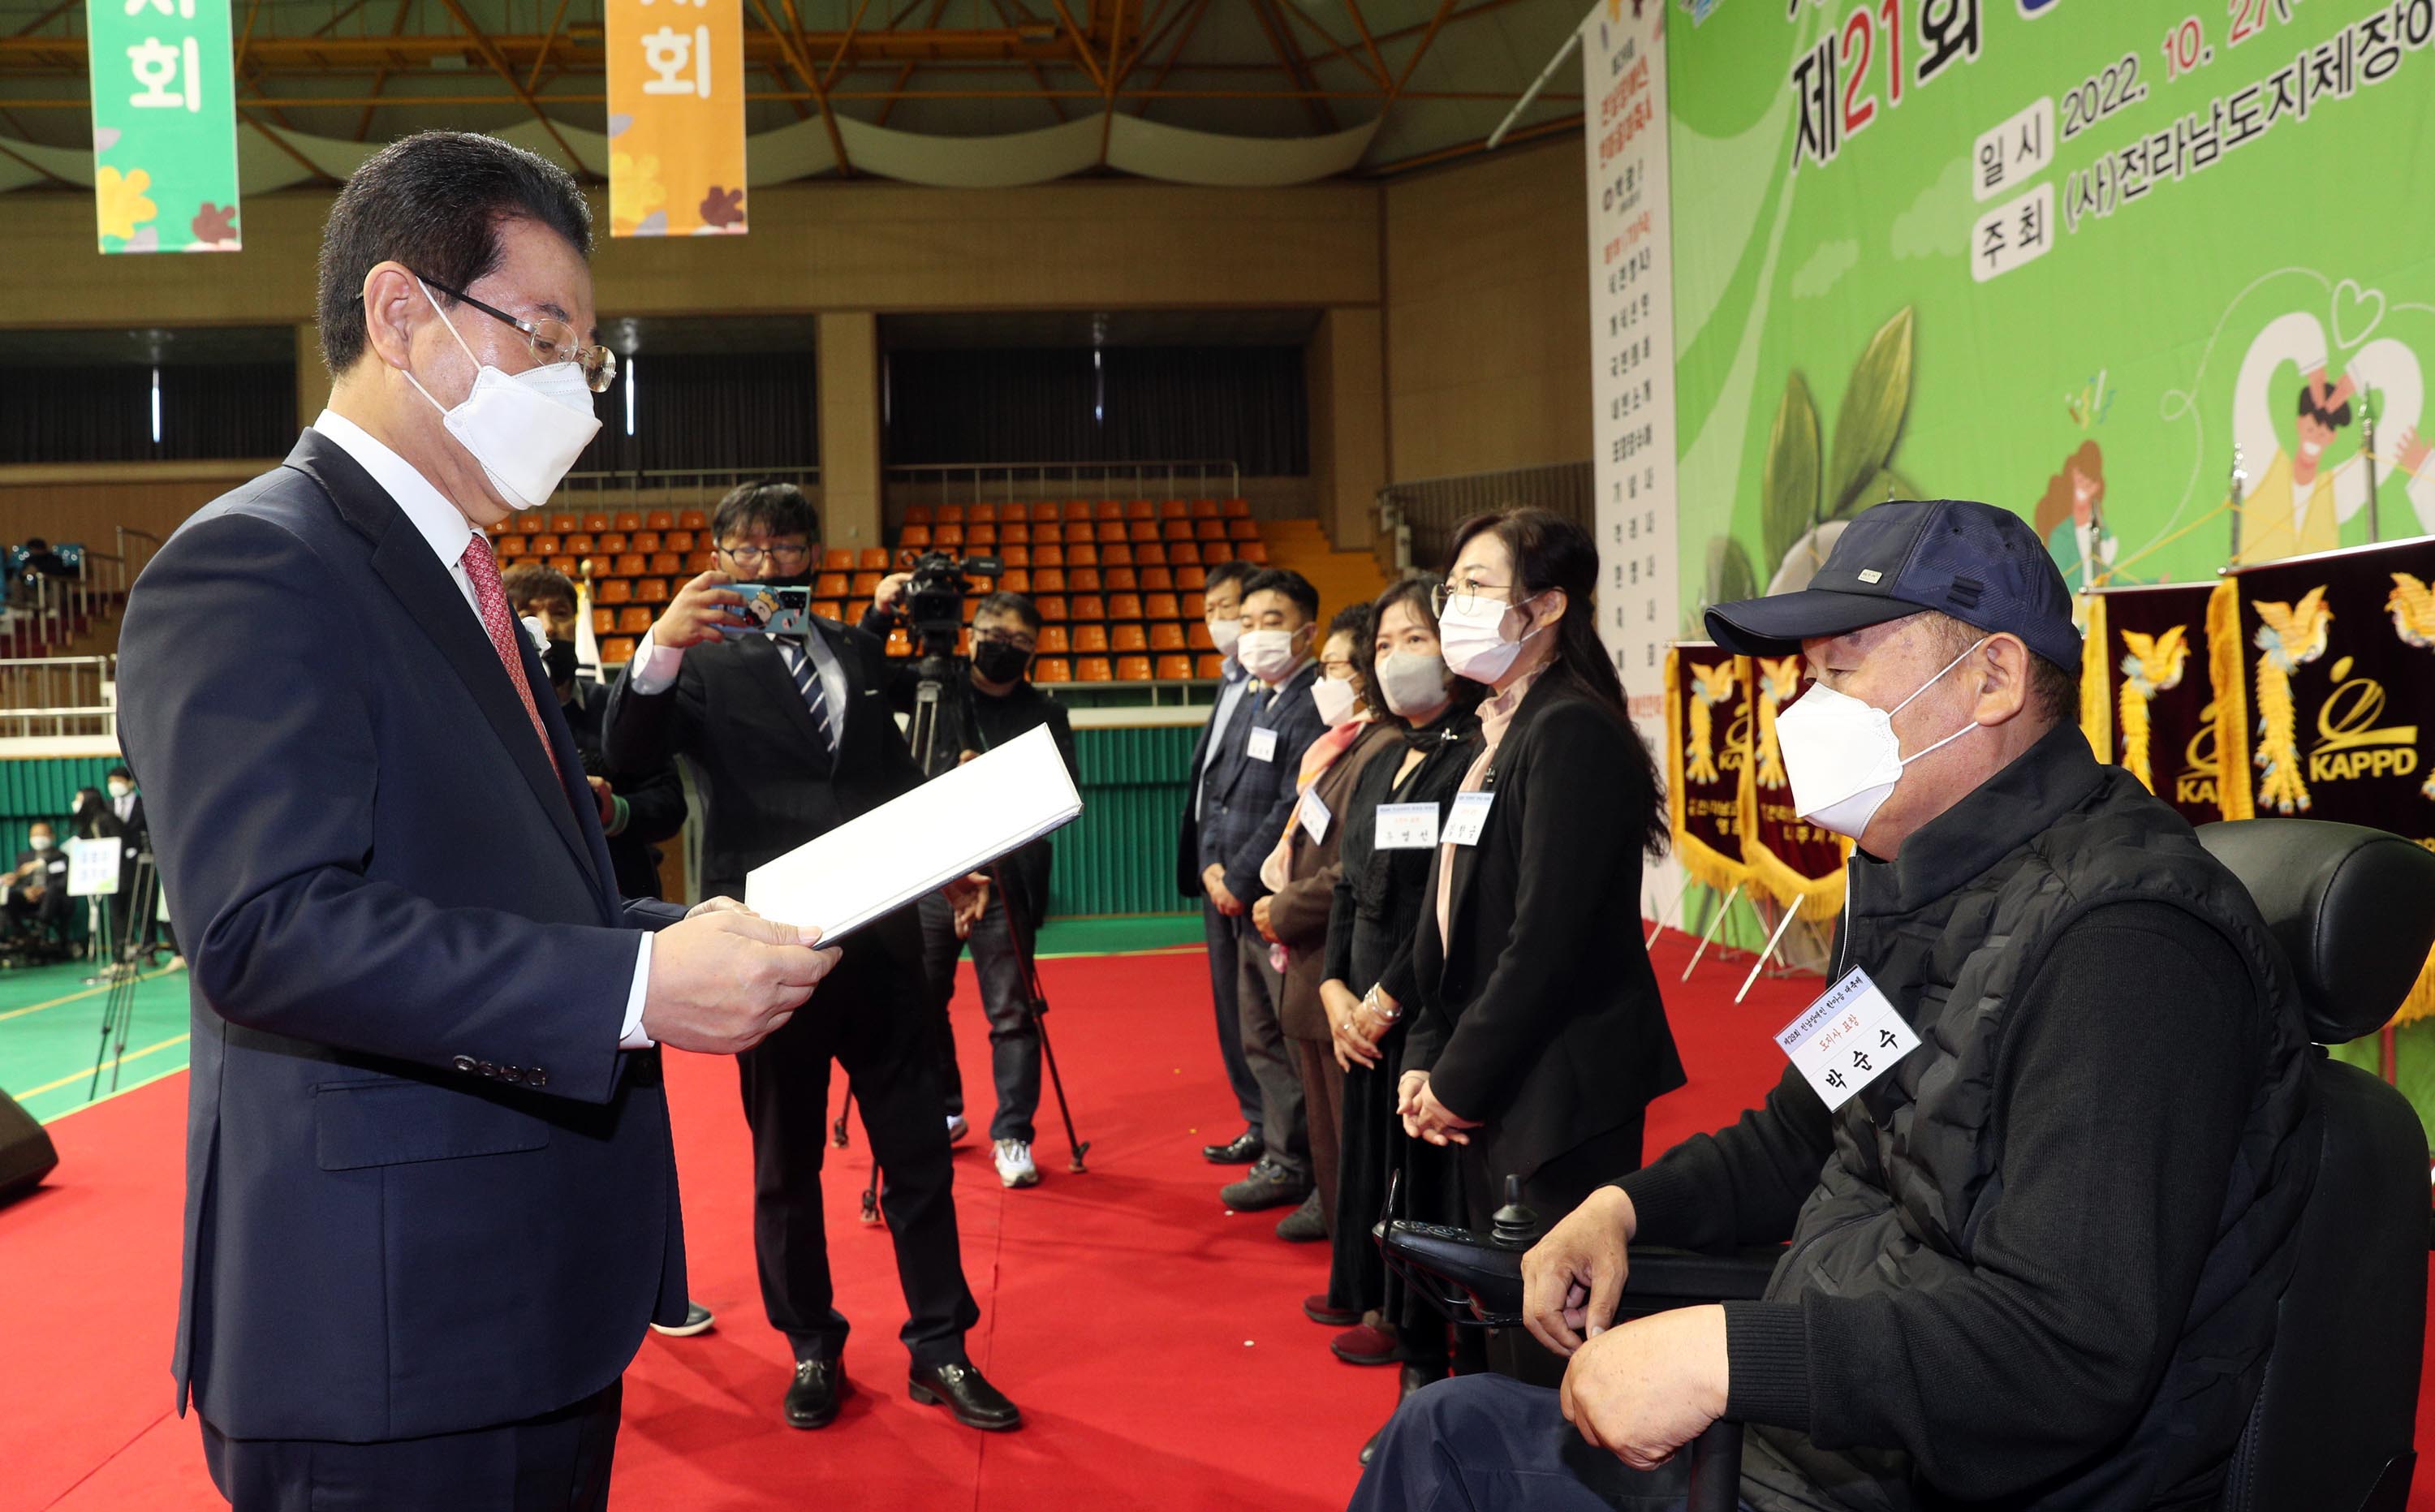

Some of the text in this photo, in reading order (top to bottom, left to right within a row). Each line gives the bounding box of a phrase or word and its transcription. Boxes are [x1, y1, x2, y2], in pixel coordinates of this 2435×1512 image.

[1791, 0, 1978, 169] 제21회
[2064, 56, 2146, 137] 2022.
[2164, 19, 2212, 79] 10.
[2309, 747, 2417, 782] KAPPD
[1826, 991, 1845, 1009] 한마음
[1844, 975, 1864, 993] 대축제
[1819, 1014, 1860, 1052] 도지사 표창
